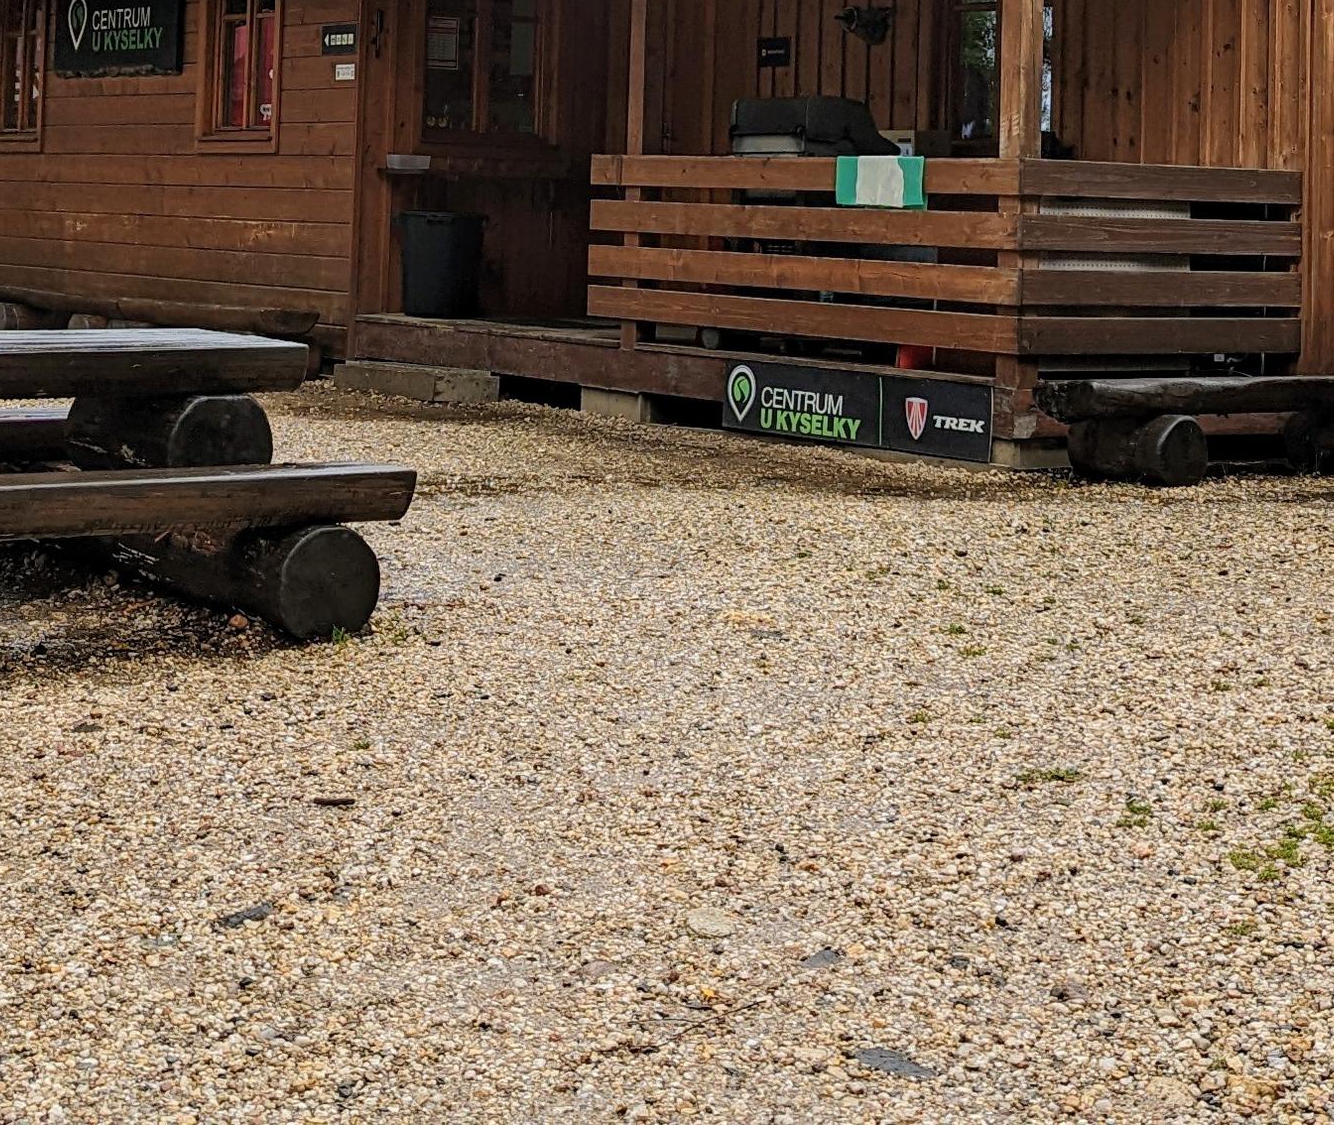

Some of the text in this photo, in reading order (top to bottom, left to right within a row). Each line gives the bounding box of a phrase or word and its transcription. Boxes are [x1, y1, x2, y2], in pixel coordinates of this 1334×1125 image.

[92, 7, 151, 30] CENTRUM
[92, 27, 163, 51] U KYSELKY
[761, 386, 843, 417] CENTRUM
[760, 408, 861, 440] U KYSELKY
[932, 415, 985, 433] TREK
